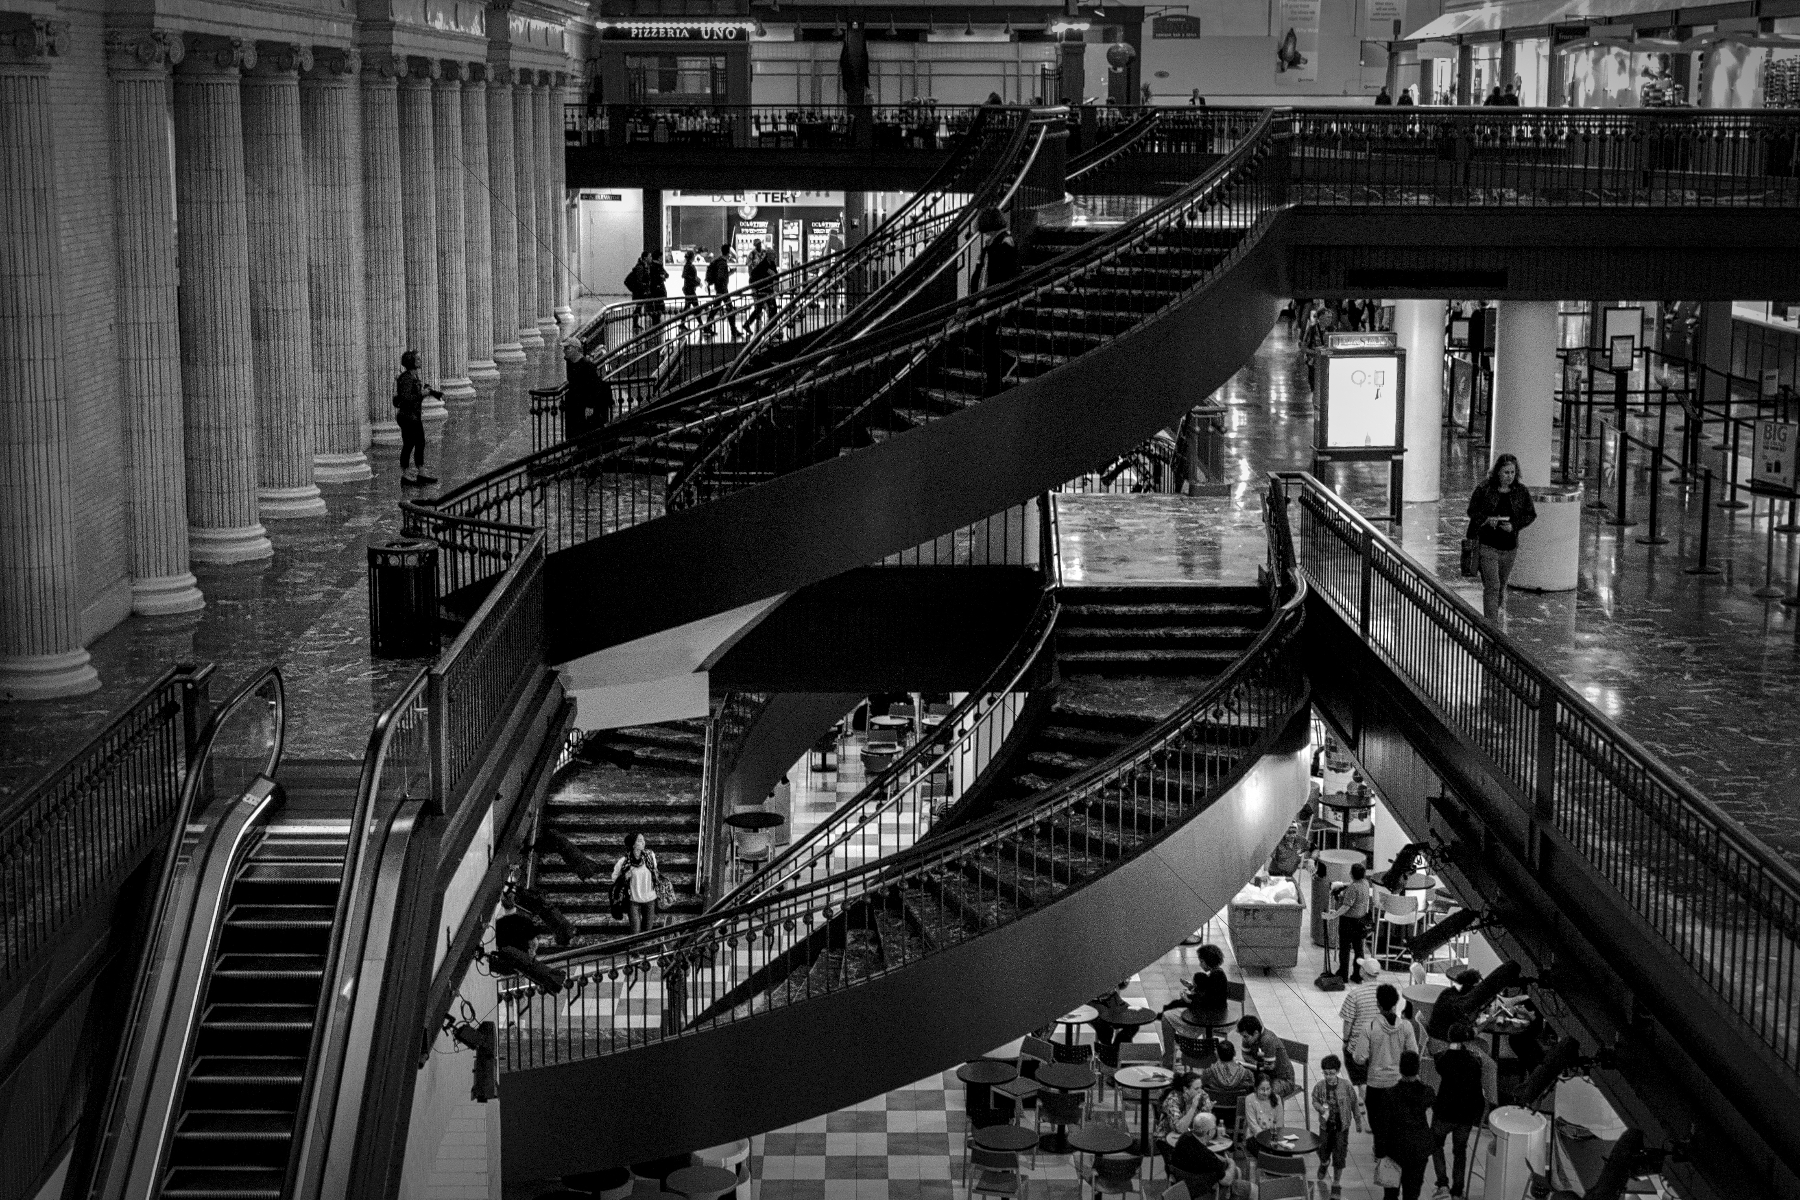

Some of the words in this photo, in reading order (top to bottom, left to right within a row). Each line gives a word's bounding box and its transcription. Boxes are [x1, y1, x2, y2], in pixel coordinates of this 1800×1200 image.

[631, 28, 690, 38] PIZZERIA
[700, 27, 737, 40] UNO
[1763, 423, 1788, 443] BIG
